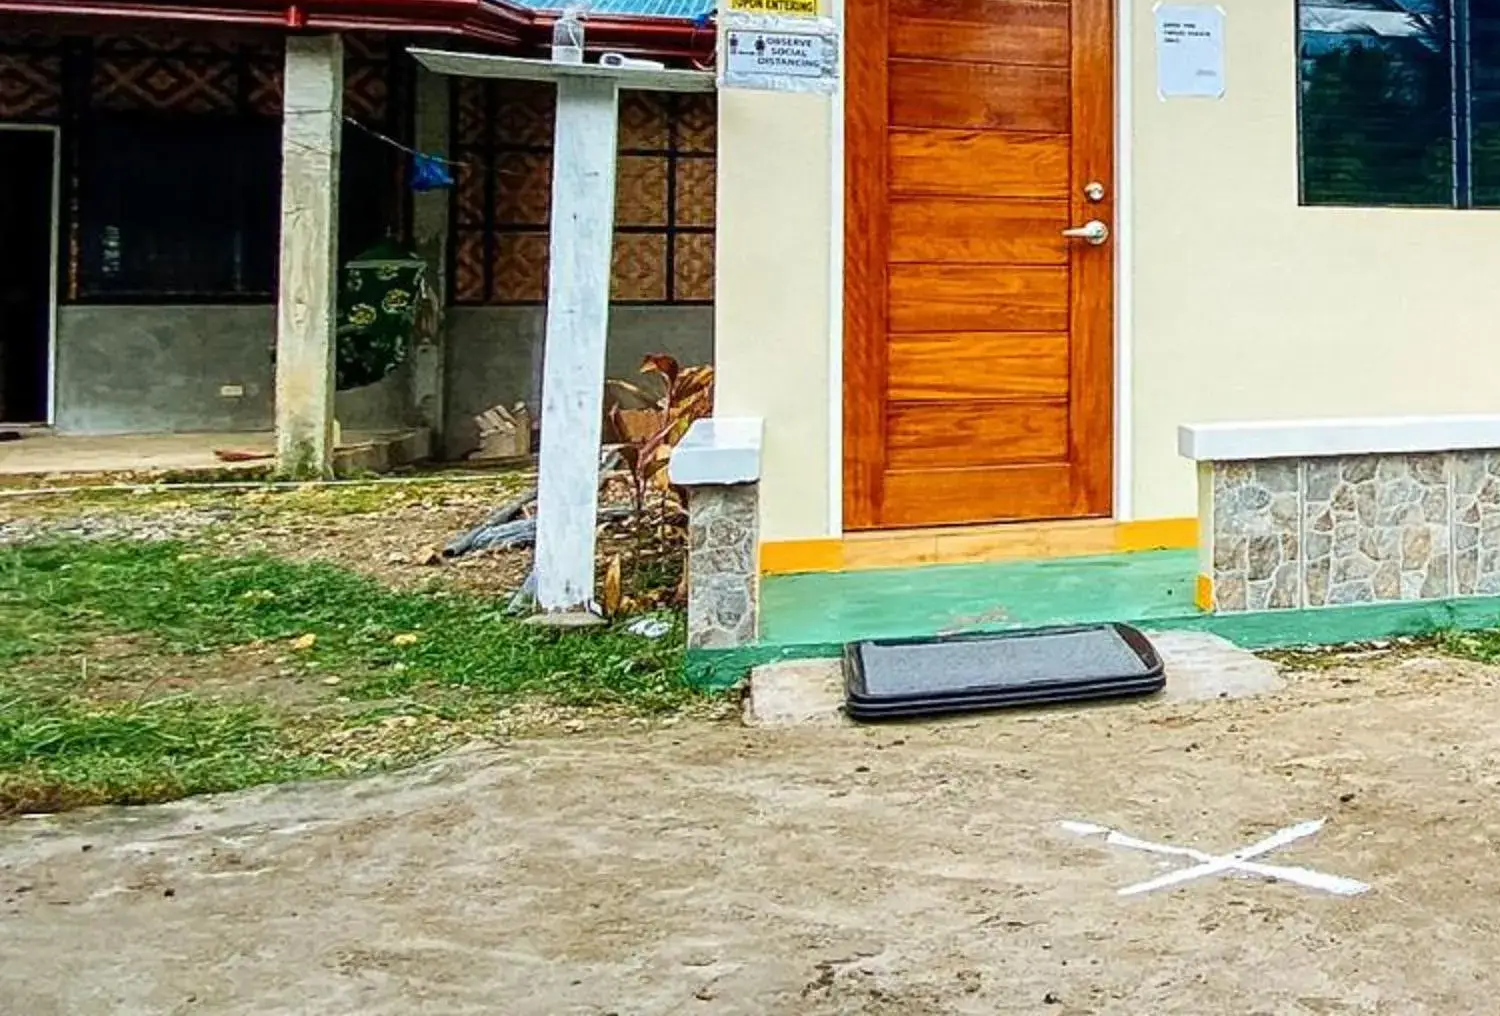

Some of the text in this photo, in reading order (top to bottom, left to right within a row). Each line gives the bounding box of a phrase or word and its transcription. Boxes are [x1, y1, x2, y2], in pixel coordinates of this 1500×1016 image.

[765, 37, 811, 47] OBSERVE
[771, 47, 807, 57] SOCIAL
[757, 58, 819, 67] DISTANCING
